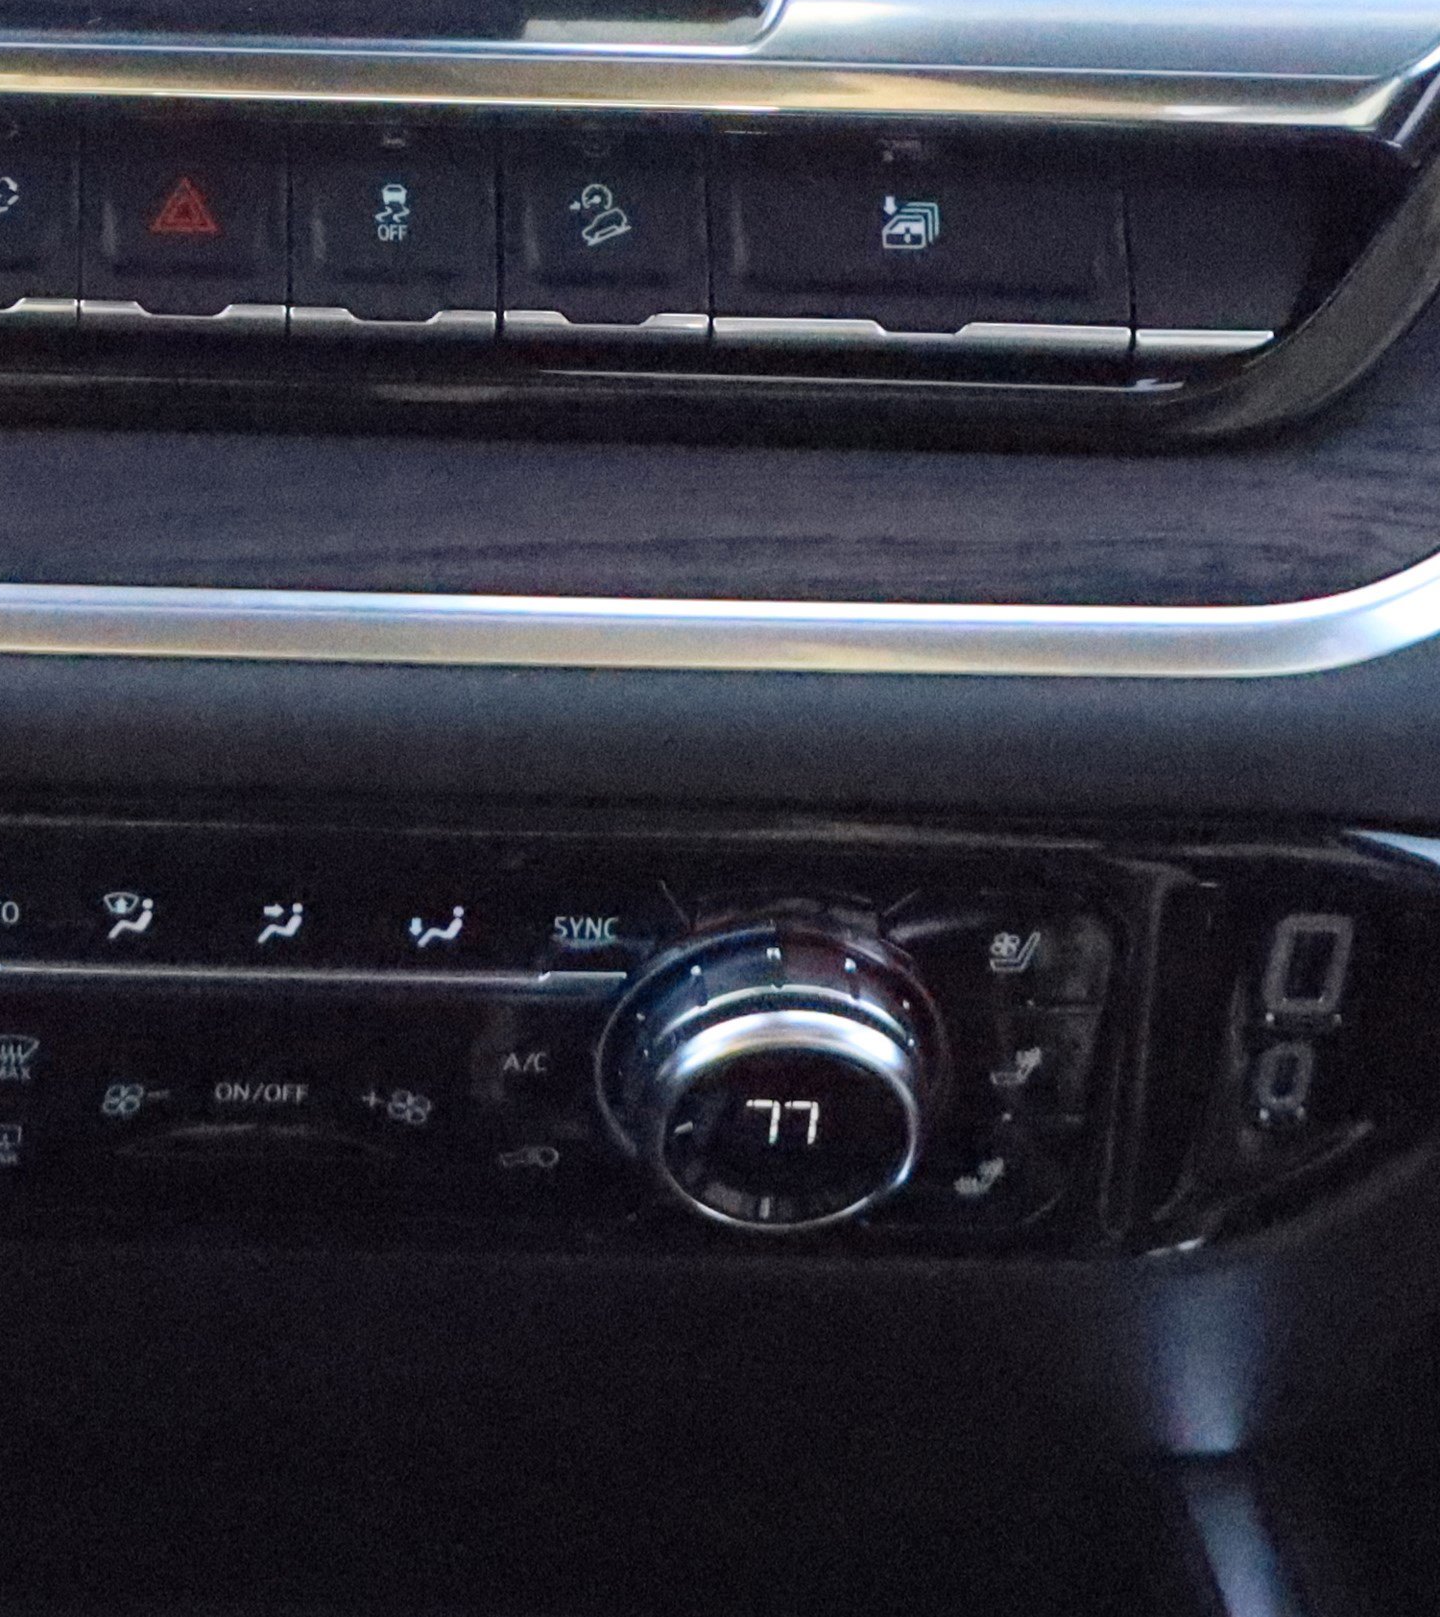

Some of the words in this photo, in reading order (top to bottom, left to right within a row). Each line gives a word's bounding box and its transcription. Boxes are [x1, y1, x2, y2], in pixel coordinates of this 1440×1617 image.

[377, 225, 409, 241] OFF
[553, 915, 619, 940] SYNC
[503, 1052, 545, 1072] A/C
[214, 1083, 308, 1105] ON/OFF
[747, 1099, 819, 1144] 77
